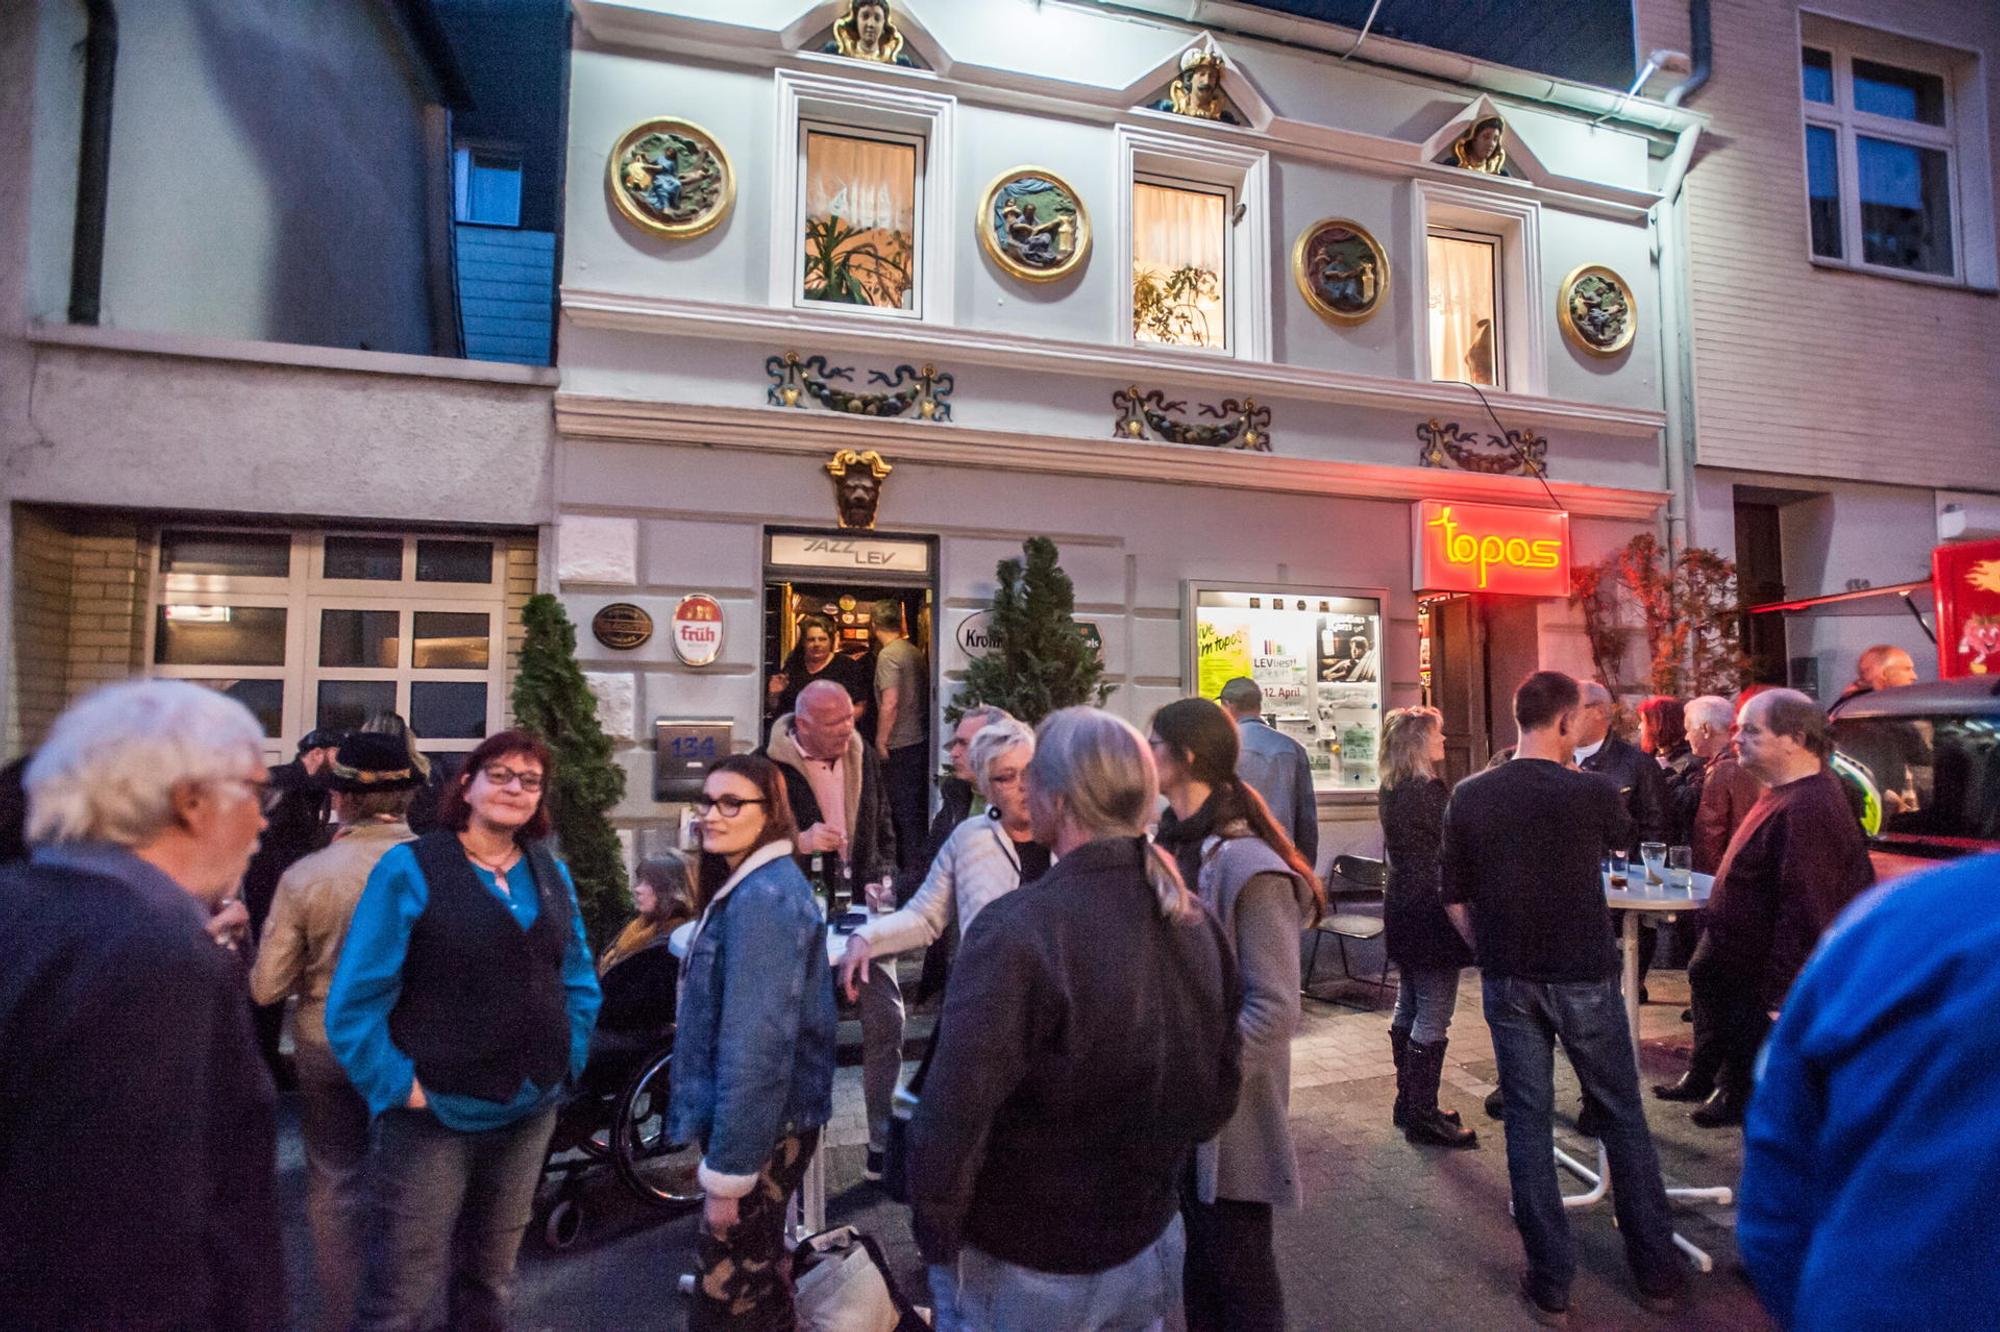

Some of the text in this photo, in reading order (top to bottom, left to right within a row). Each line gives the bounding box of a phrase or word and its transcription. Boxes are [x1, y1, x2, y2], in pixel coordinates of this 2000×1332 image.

[802, 537, 856, 554] JAZZ
[1426, 506, 1563, 590] topos
[854, 550, 896, 565] LEV
[1278, 687, 1300, 700] April
[671, 735, 716, 758] 134
